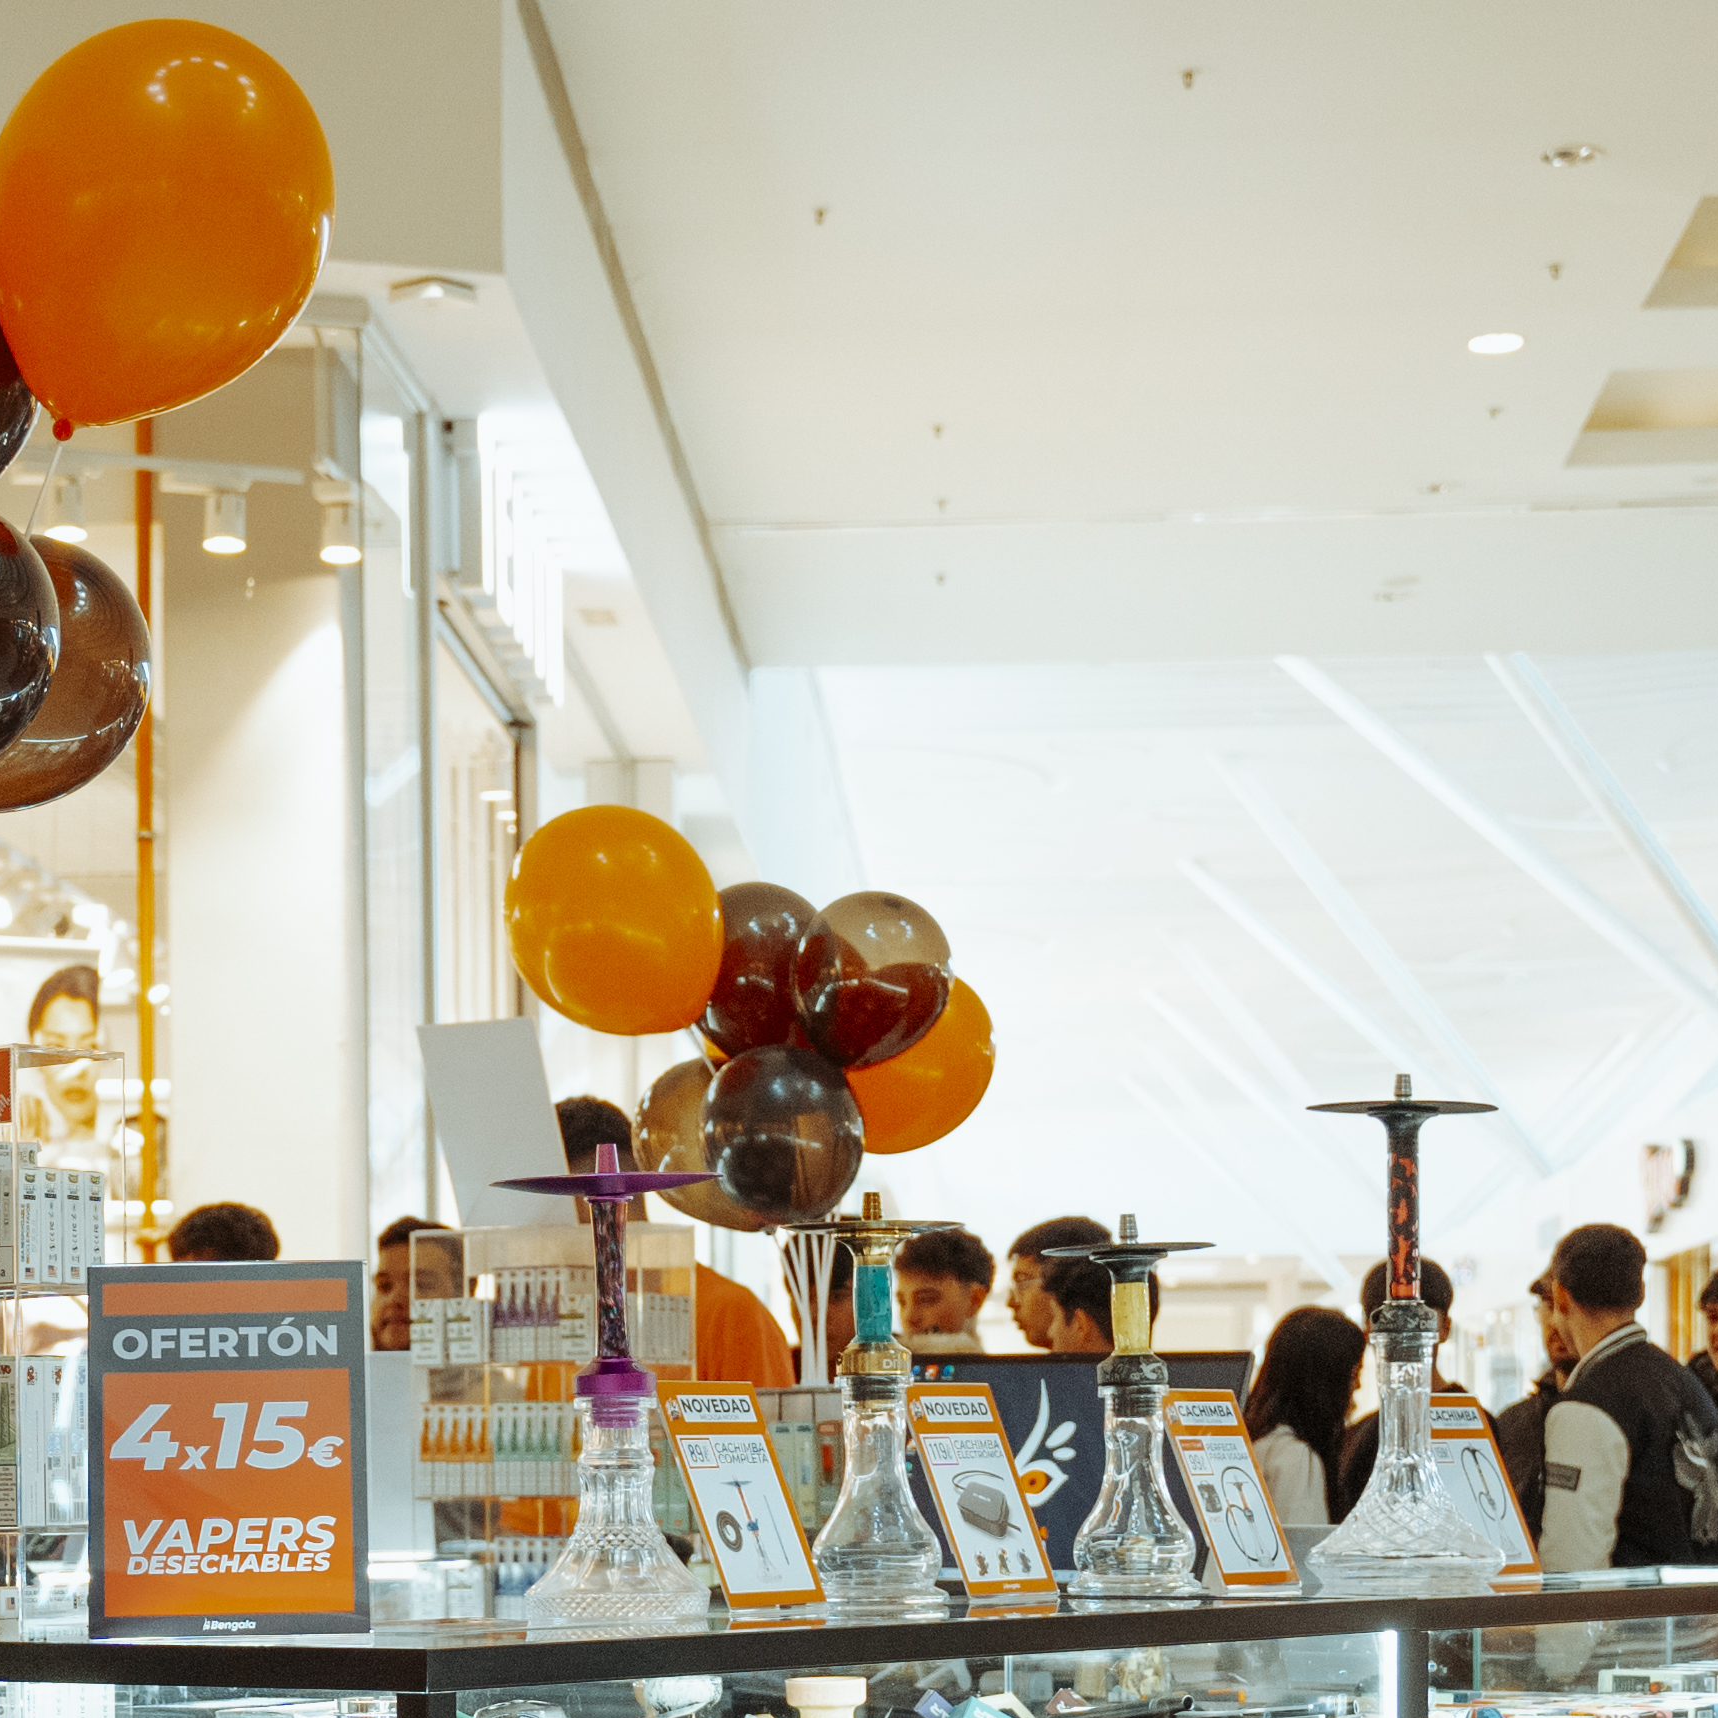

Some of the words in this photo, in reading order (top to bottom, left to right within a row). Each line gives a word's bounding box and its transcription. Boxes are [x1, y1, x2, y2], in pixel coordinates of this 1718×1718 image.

[112, 1316, 339, 1360] OFERTÓN
[680, 1399, 751, 1413] NOVEDAD
[925, 1402, 988, 1416] NOVEDAD
[1178, 1405, 1233, 1417] CACHIMBA
[1429, 1410, 1478, 1422] CACHIMBA
[109, 1400, 345, 1471] 4x15€
[714, 1443, 765, 1453] CACHIMBA
[954, 1440, 999, 1450] CACHIMBA
[1205, 1443, 1238, 1452] PERFECTA
[718, 1453, 770, 1464] COMPLETA
[123, 1515, 337, 1554] VAPERS
[127, 1552, 331, 1575] DESECHABLES
[210, 1619, 257, 1632] Bengala
